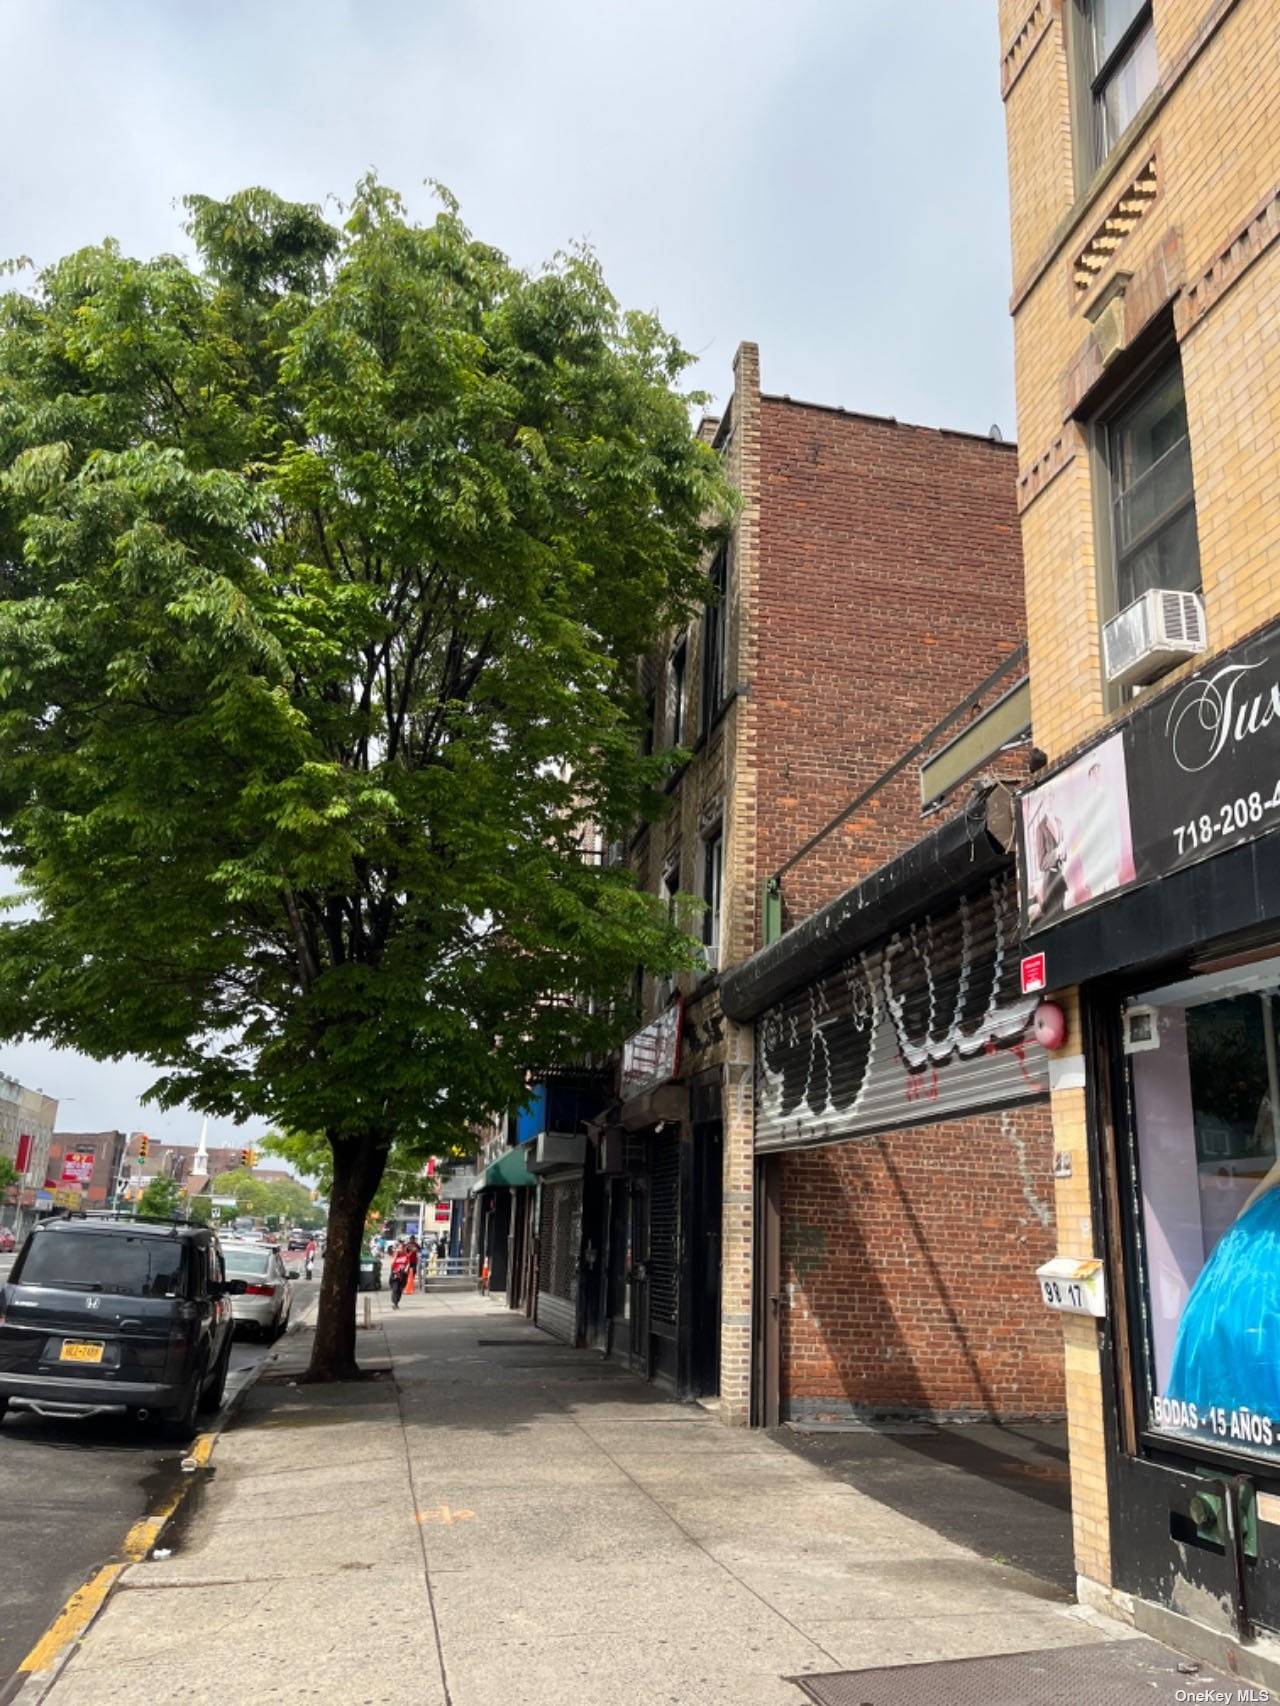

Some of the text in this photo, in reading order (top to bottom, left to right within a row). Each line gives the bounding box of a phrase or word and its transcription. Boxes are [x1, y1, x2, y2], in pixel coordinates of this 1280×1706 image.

[1044, 1282, 1082, 1307] 98 17
[1153, 1396, 1198, 1430] BODAS
[1210, 1406, 1227, 1436] 15
[1230, 1406, 1273, 1446] AÑOS
